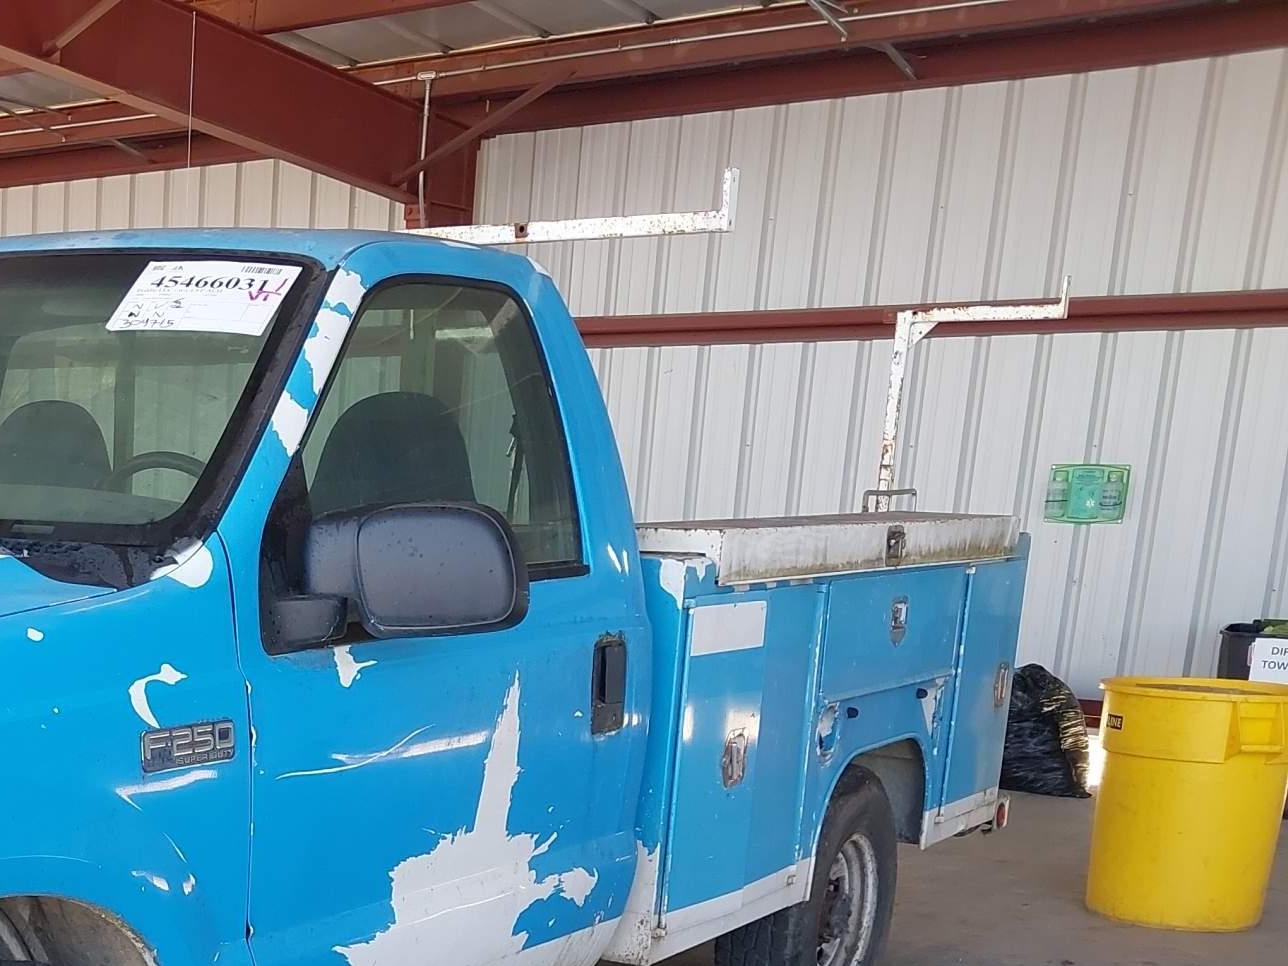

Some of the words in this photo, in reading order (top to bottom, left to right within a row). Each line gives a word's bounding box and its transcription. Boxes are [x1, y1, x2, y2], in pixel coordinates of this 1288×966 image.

[150, 275, 270, 292] 45466031
[175, 753, 208, 765] SUPER
[208, 748, 233, 760] DUTY
